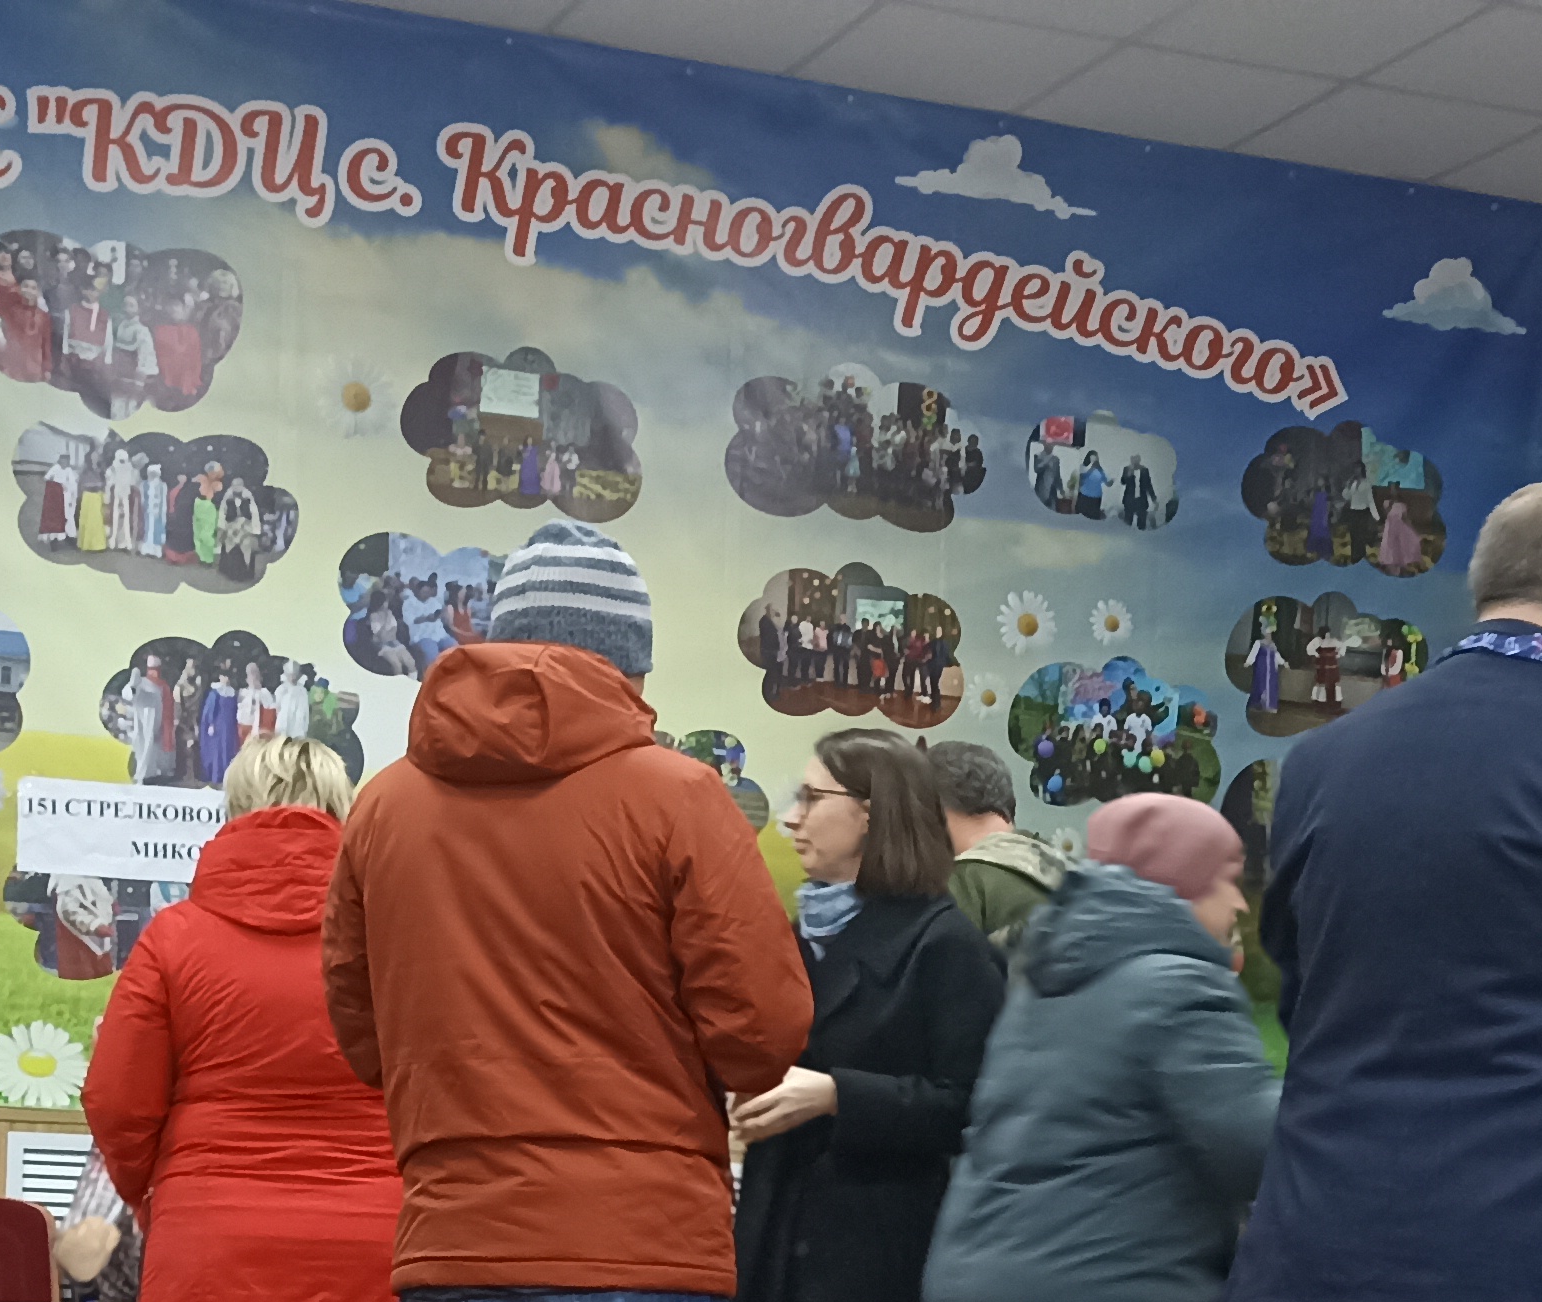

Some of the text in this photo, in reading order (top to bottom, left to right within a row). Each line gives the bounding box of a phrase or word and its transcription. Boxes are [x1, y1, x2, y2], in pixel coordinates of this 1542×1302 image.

[343, 143, 417, 209] с.
[443, 130, 1343, 411] Красногвардейского»
[23, 797, 57, 816] 151
